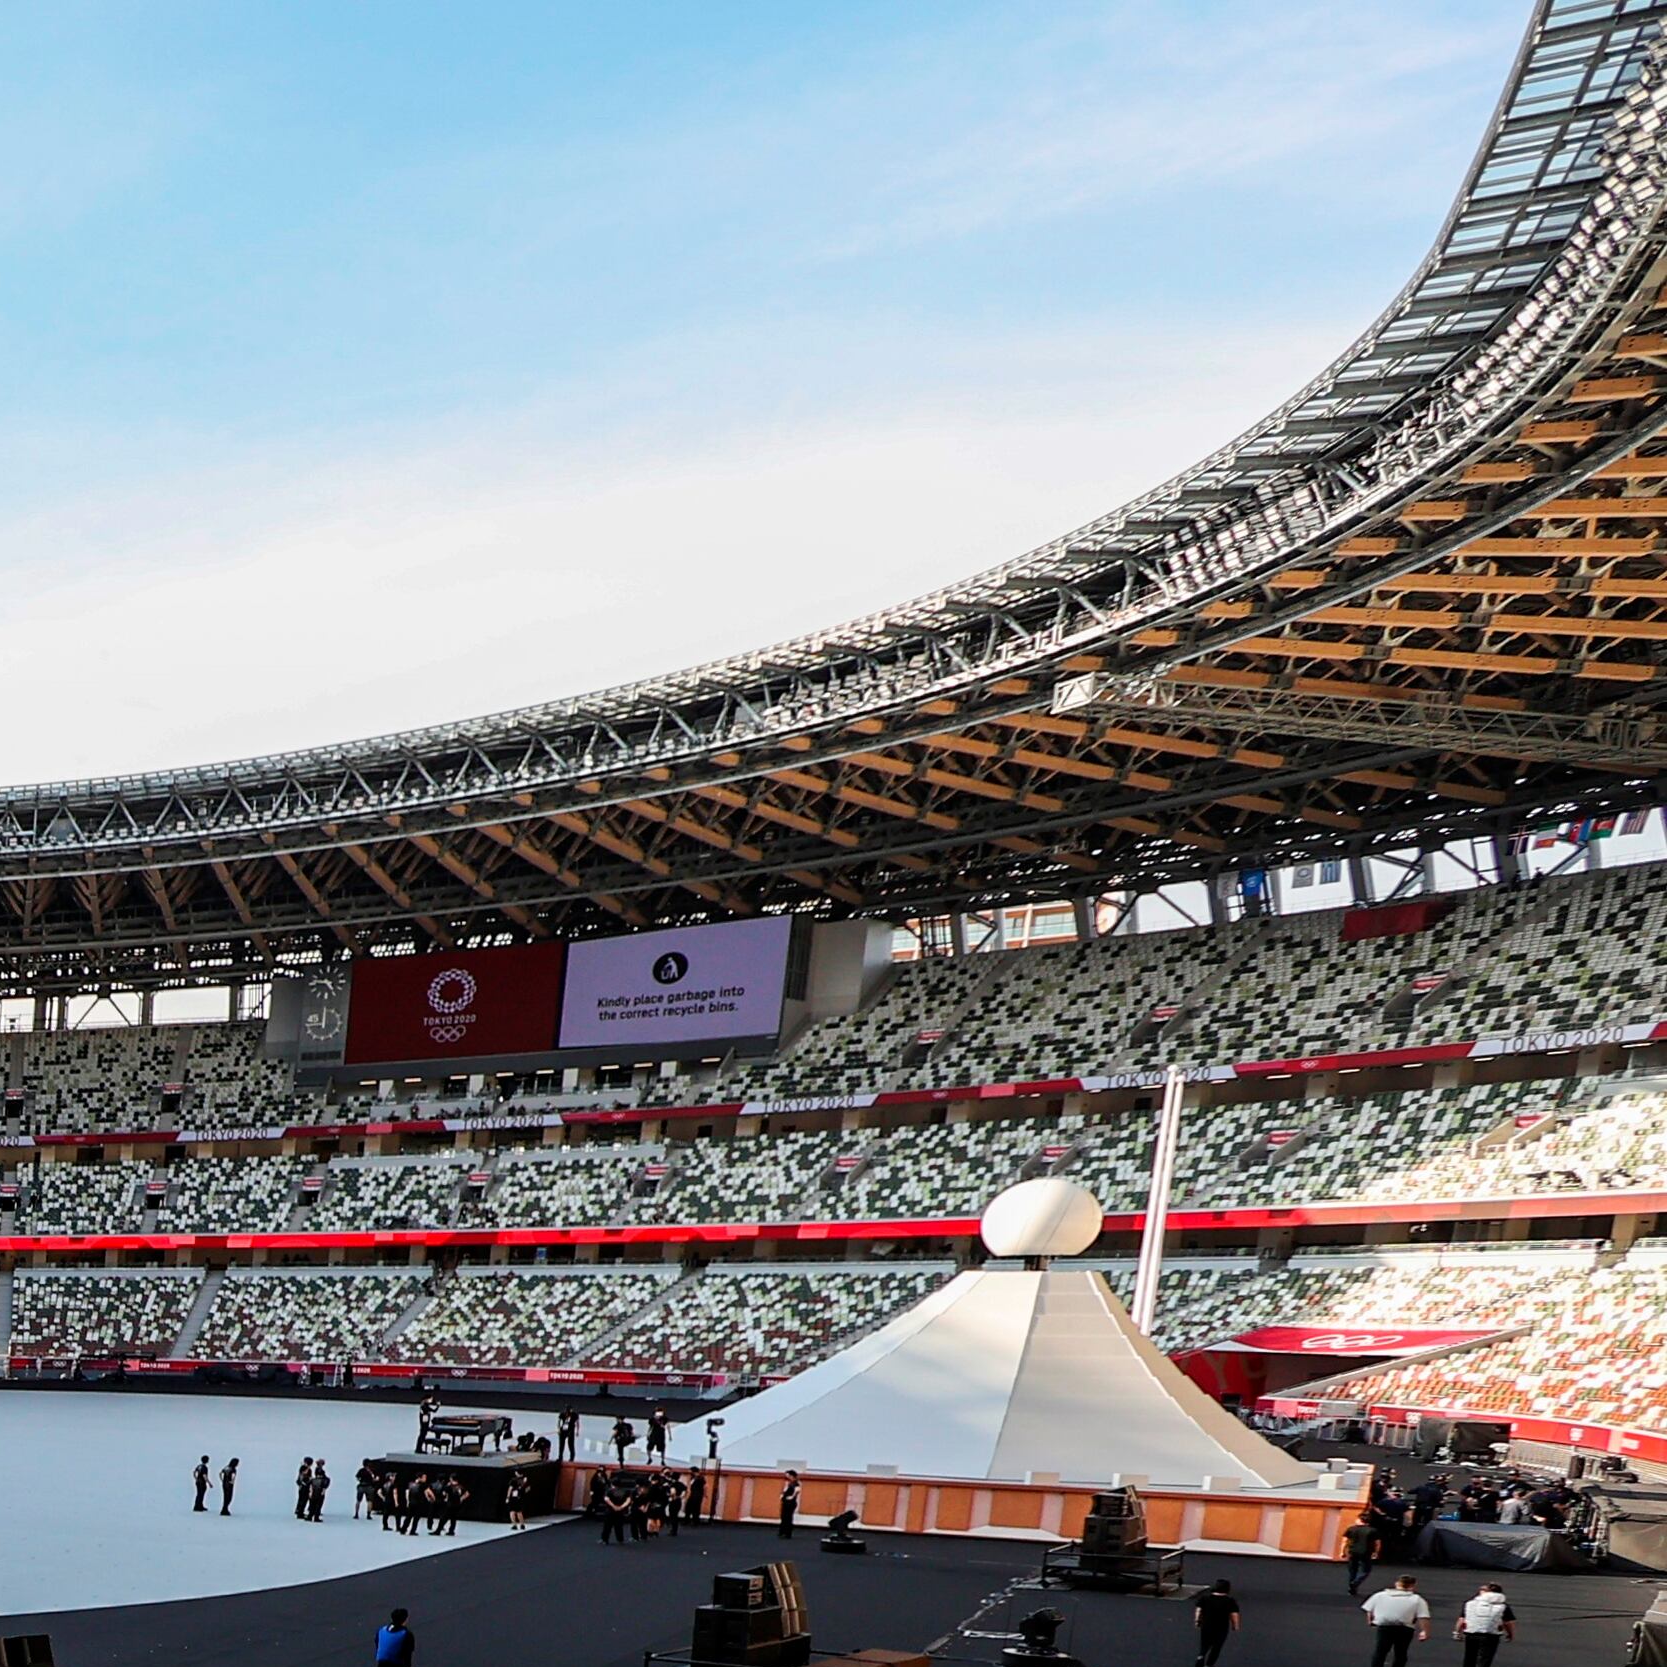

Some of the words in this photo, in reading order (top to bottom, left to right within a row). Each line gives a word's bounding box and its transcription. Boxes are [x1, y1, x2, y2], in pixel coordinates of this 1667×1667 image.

[597, 996, 632, 1008] Kindly
[634, 994, 664, 1007] place
[667, 990, 715, 1003] garbage
[720, 986, 745, 997] into
[599, 1010, 616, 1021] the
[620, 1008, 659, 1019] correct
[662, 1003, 705, 1017] recycle
[709, 1001, 739, 1013] bins.
[423, 1017, 452, 1026] TOKYO
[454, 1014, 476, 1023] 2020
[1500, 1033, 1566, 1056] TOKYO
[1573, 1026, 1624, 1048] 2020
[1107, 1072, 1163, 1088] TOKYO
[763, 1098, 811, 1114] TOKYO
[815, 1096, 854, 1110] 2020
[463, 1118, 505, 1132] TOKYO
[510, 1117, 544, 1128] 2020
[195, 1129, 234, 1141] TOKYO
[238, 1128, 267, 1139] 2020
